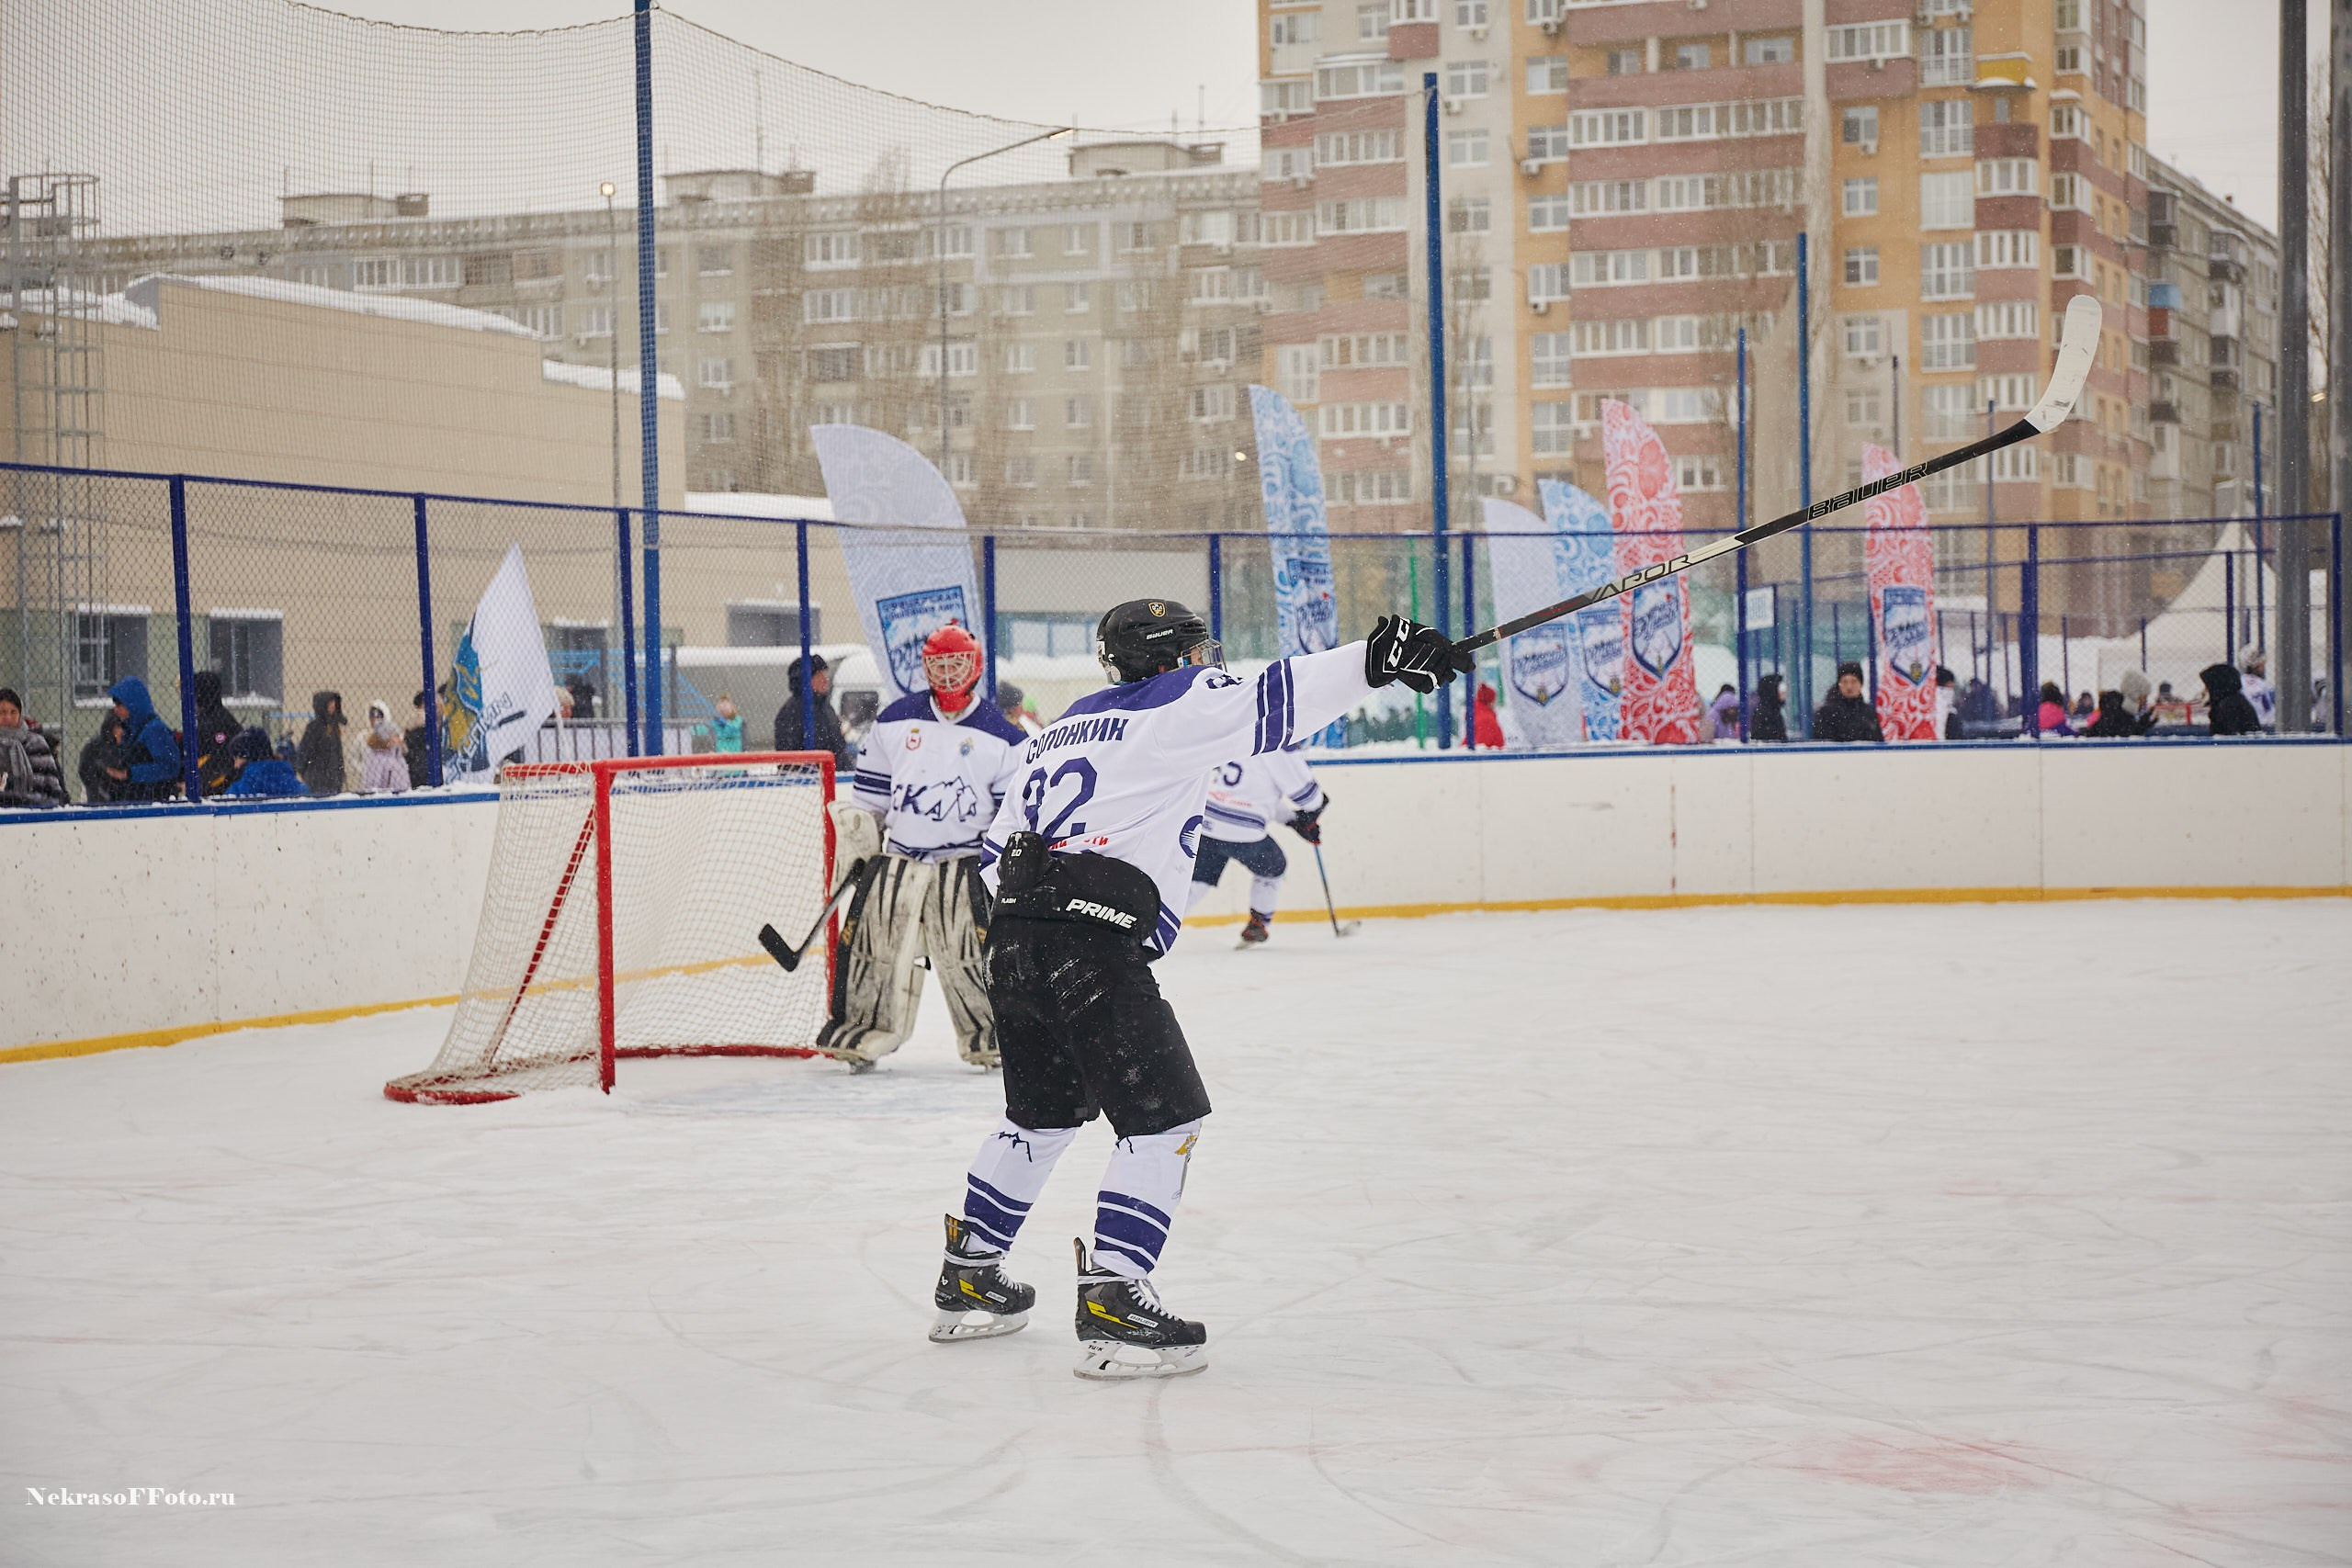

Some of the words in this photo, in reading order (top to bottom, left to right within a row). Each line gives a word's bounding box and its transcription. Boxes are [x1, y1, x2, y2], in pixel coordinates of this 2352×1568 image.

[1807, 461, 1928, 522] BAUER
[1386, 616, 1411, 668] CC
[1065, 898, 1138, 930] PRIME
